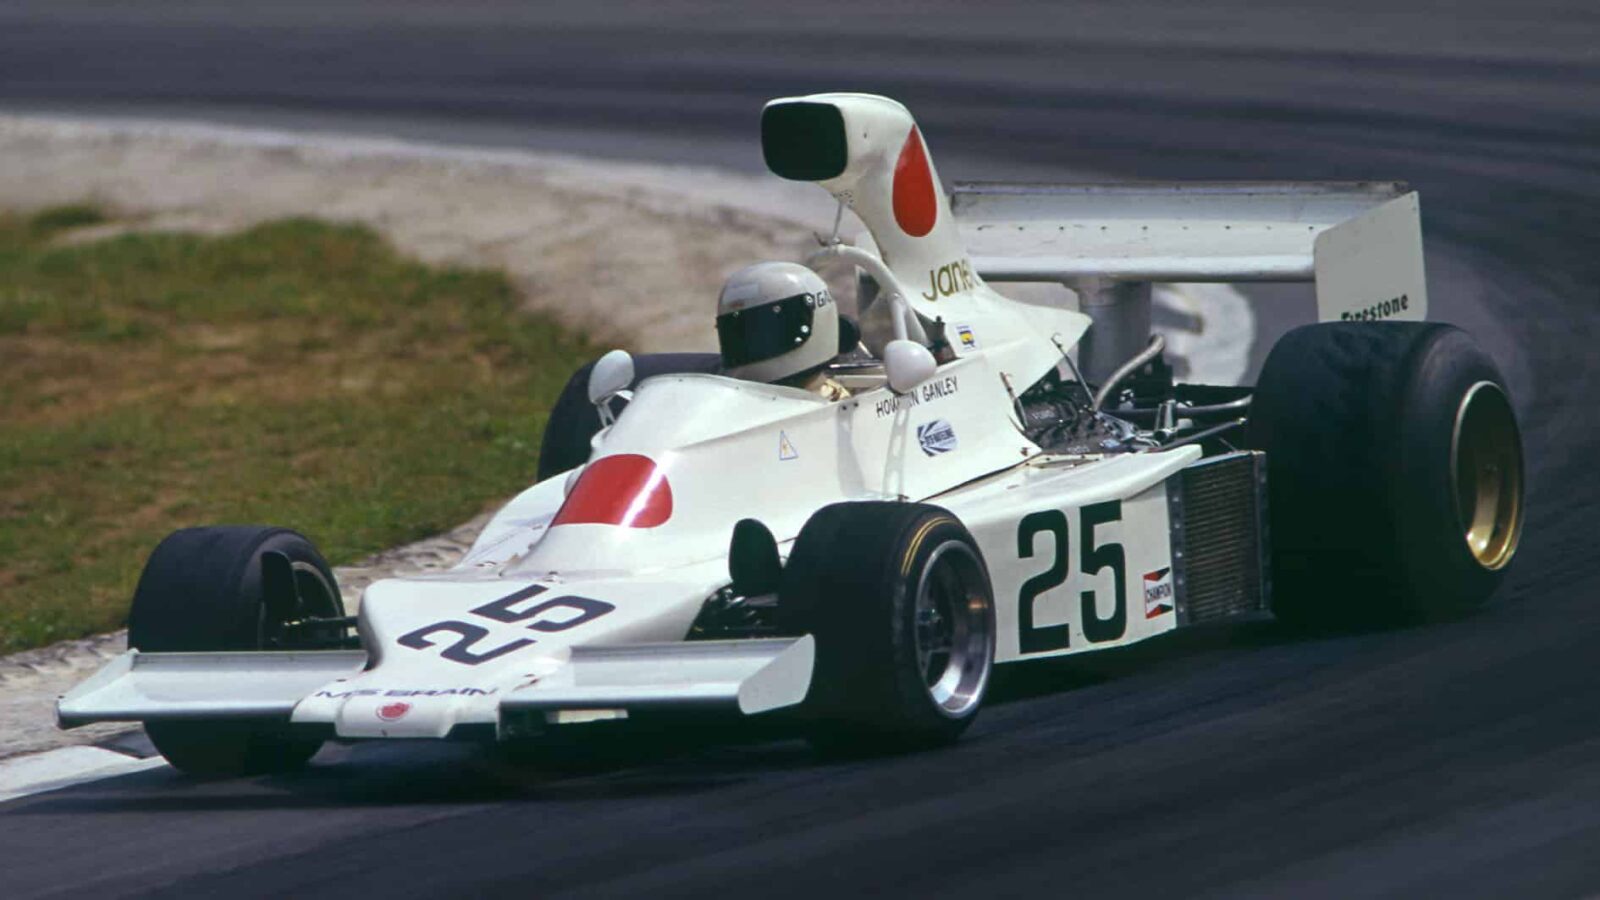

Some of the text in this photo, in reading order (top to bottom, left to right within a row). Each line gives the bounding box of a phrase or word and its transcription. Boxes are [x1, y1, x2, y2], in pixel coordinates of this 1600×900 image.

[876, 375, 958, 418] HOWN GANLEY
[1017, 498, 1127, 655] 25
[396, 583, 617, 666] 25
